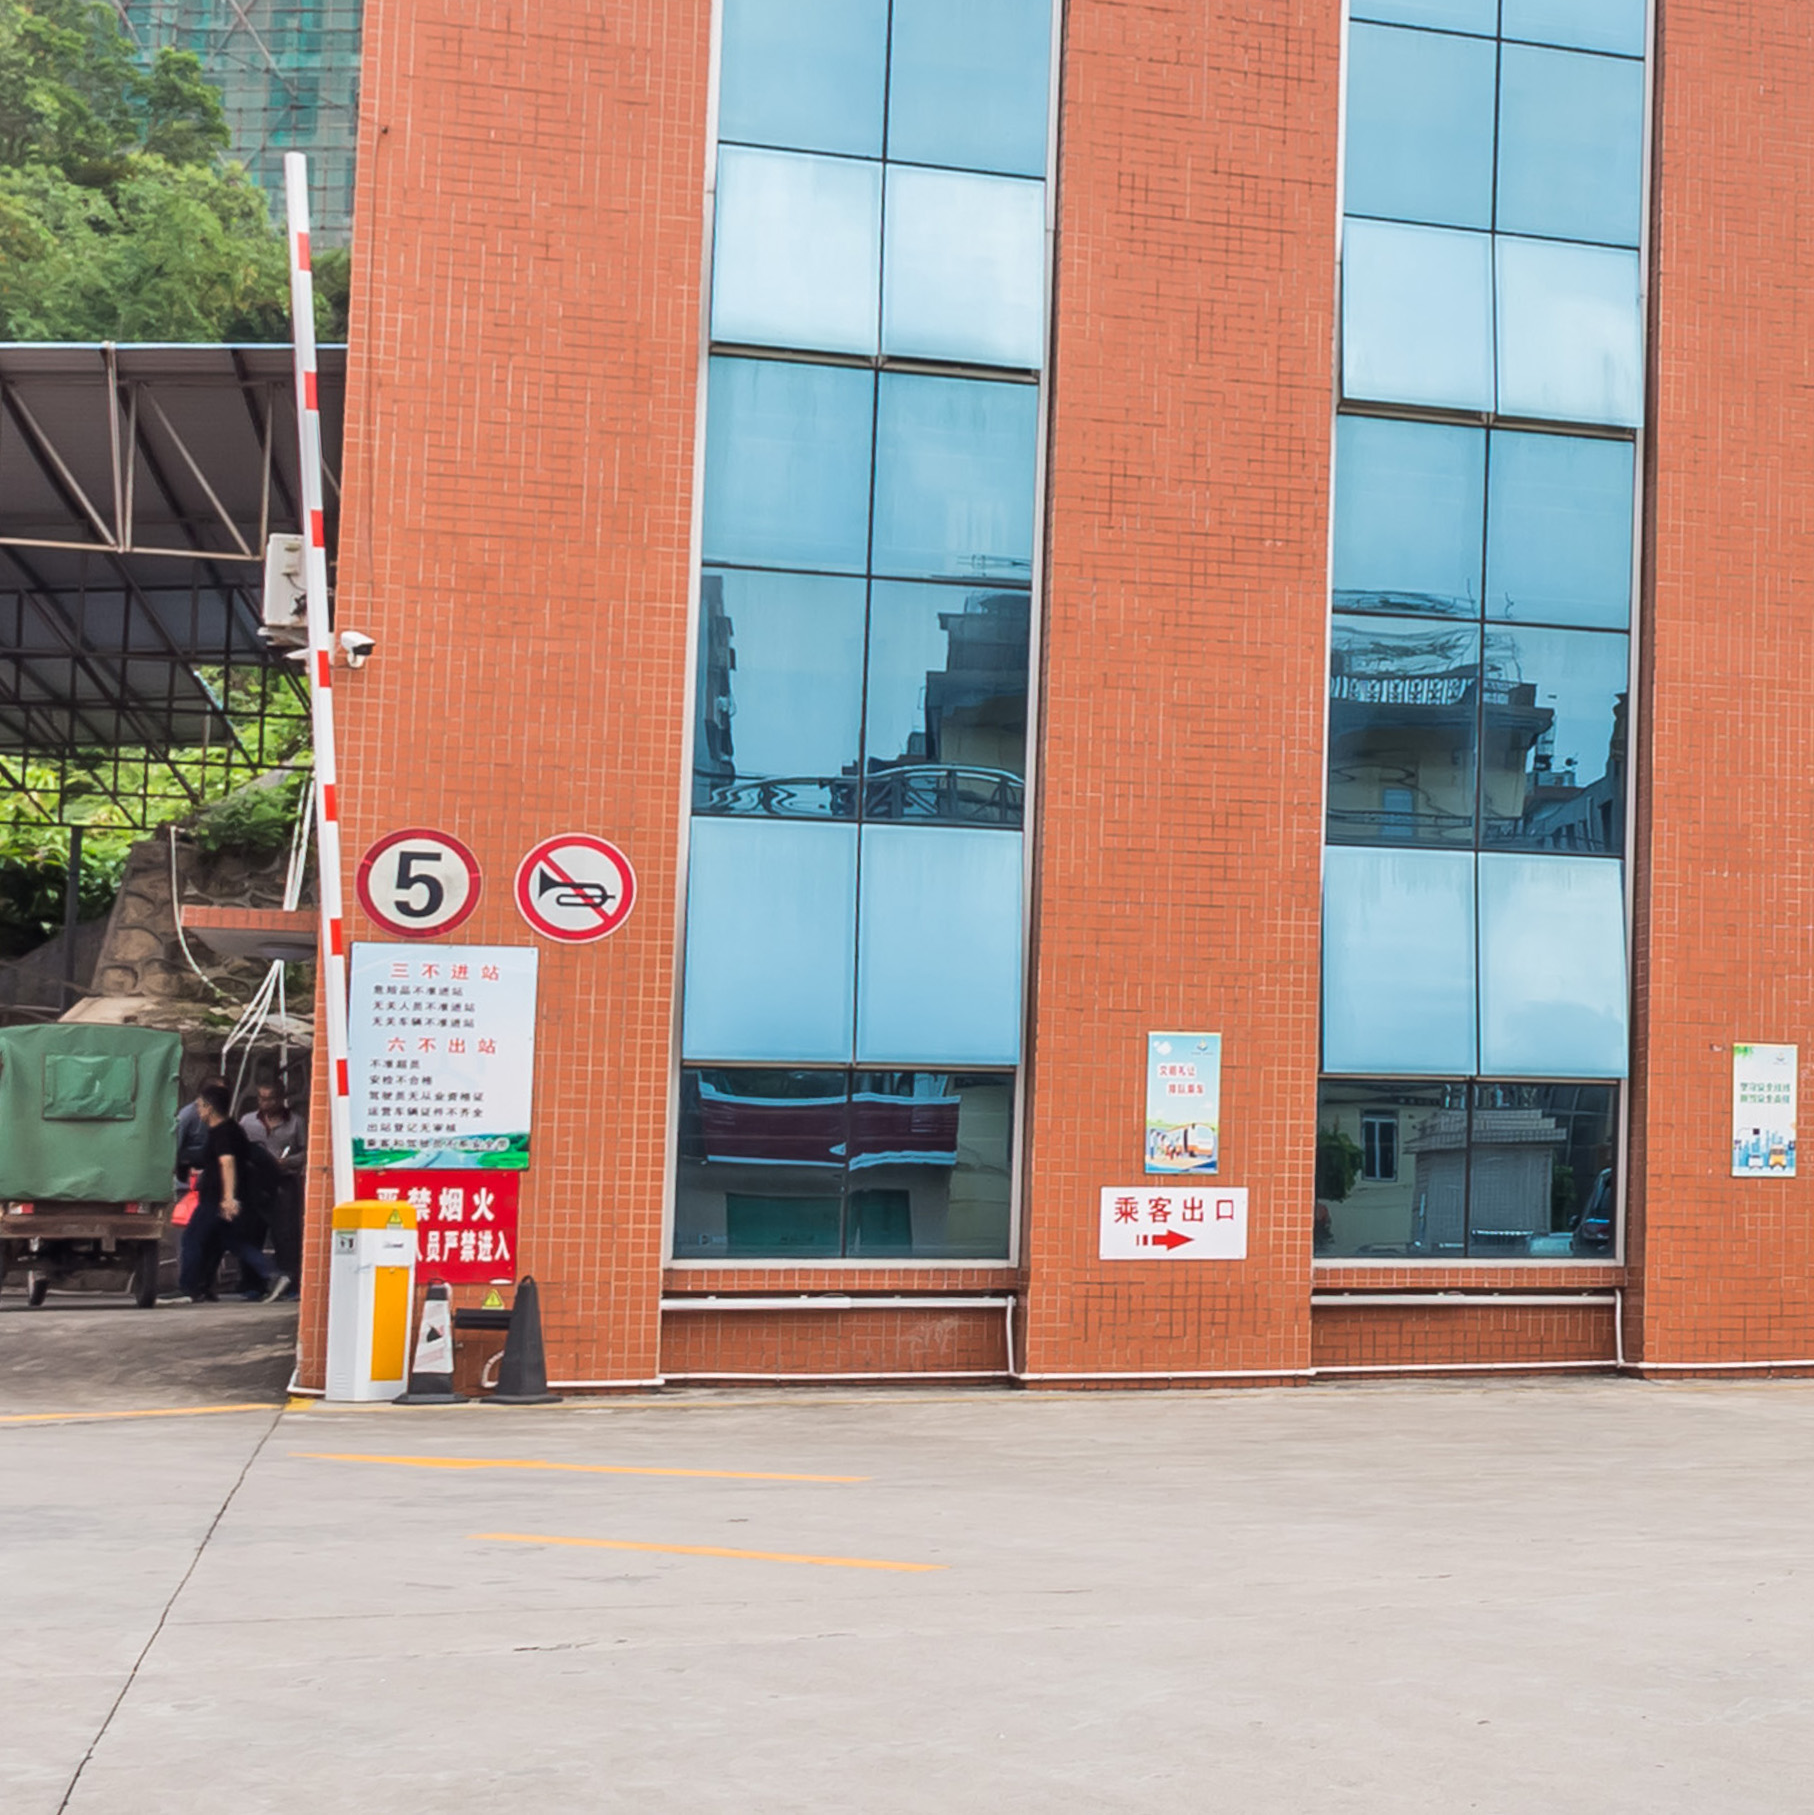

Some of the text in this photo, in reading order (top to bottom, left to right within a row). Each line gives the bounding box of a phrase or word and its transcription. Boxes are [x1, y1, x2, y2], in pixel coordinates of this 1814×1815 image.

[394, 851, 444, 917] 5
[391, 962, 499, 981] 三不进站
[387, 1037, 496, 1054] 六不出站
[1114, 1197, 1235, 1224] 乘客出口
[415, 1229, 511, 1263] 员严禁进入
